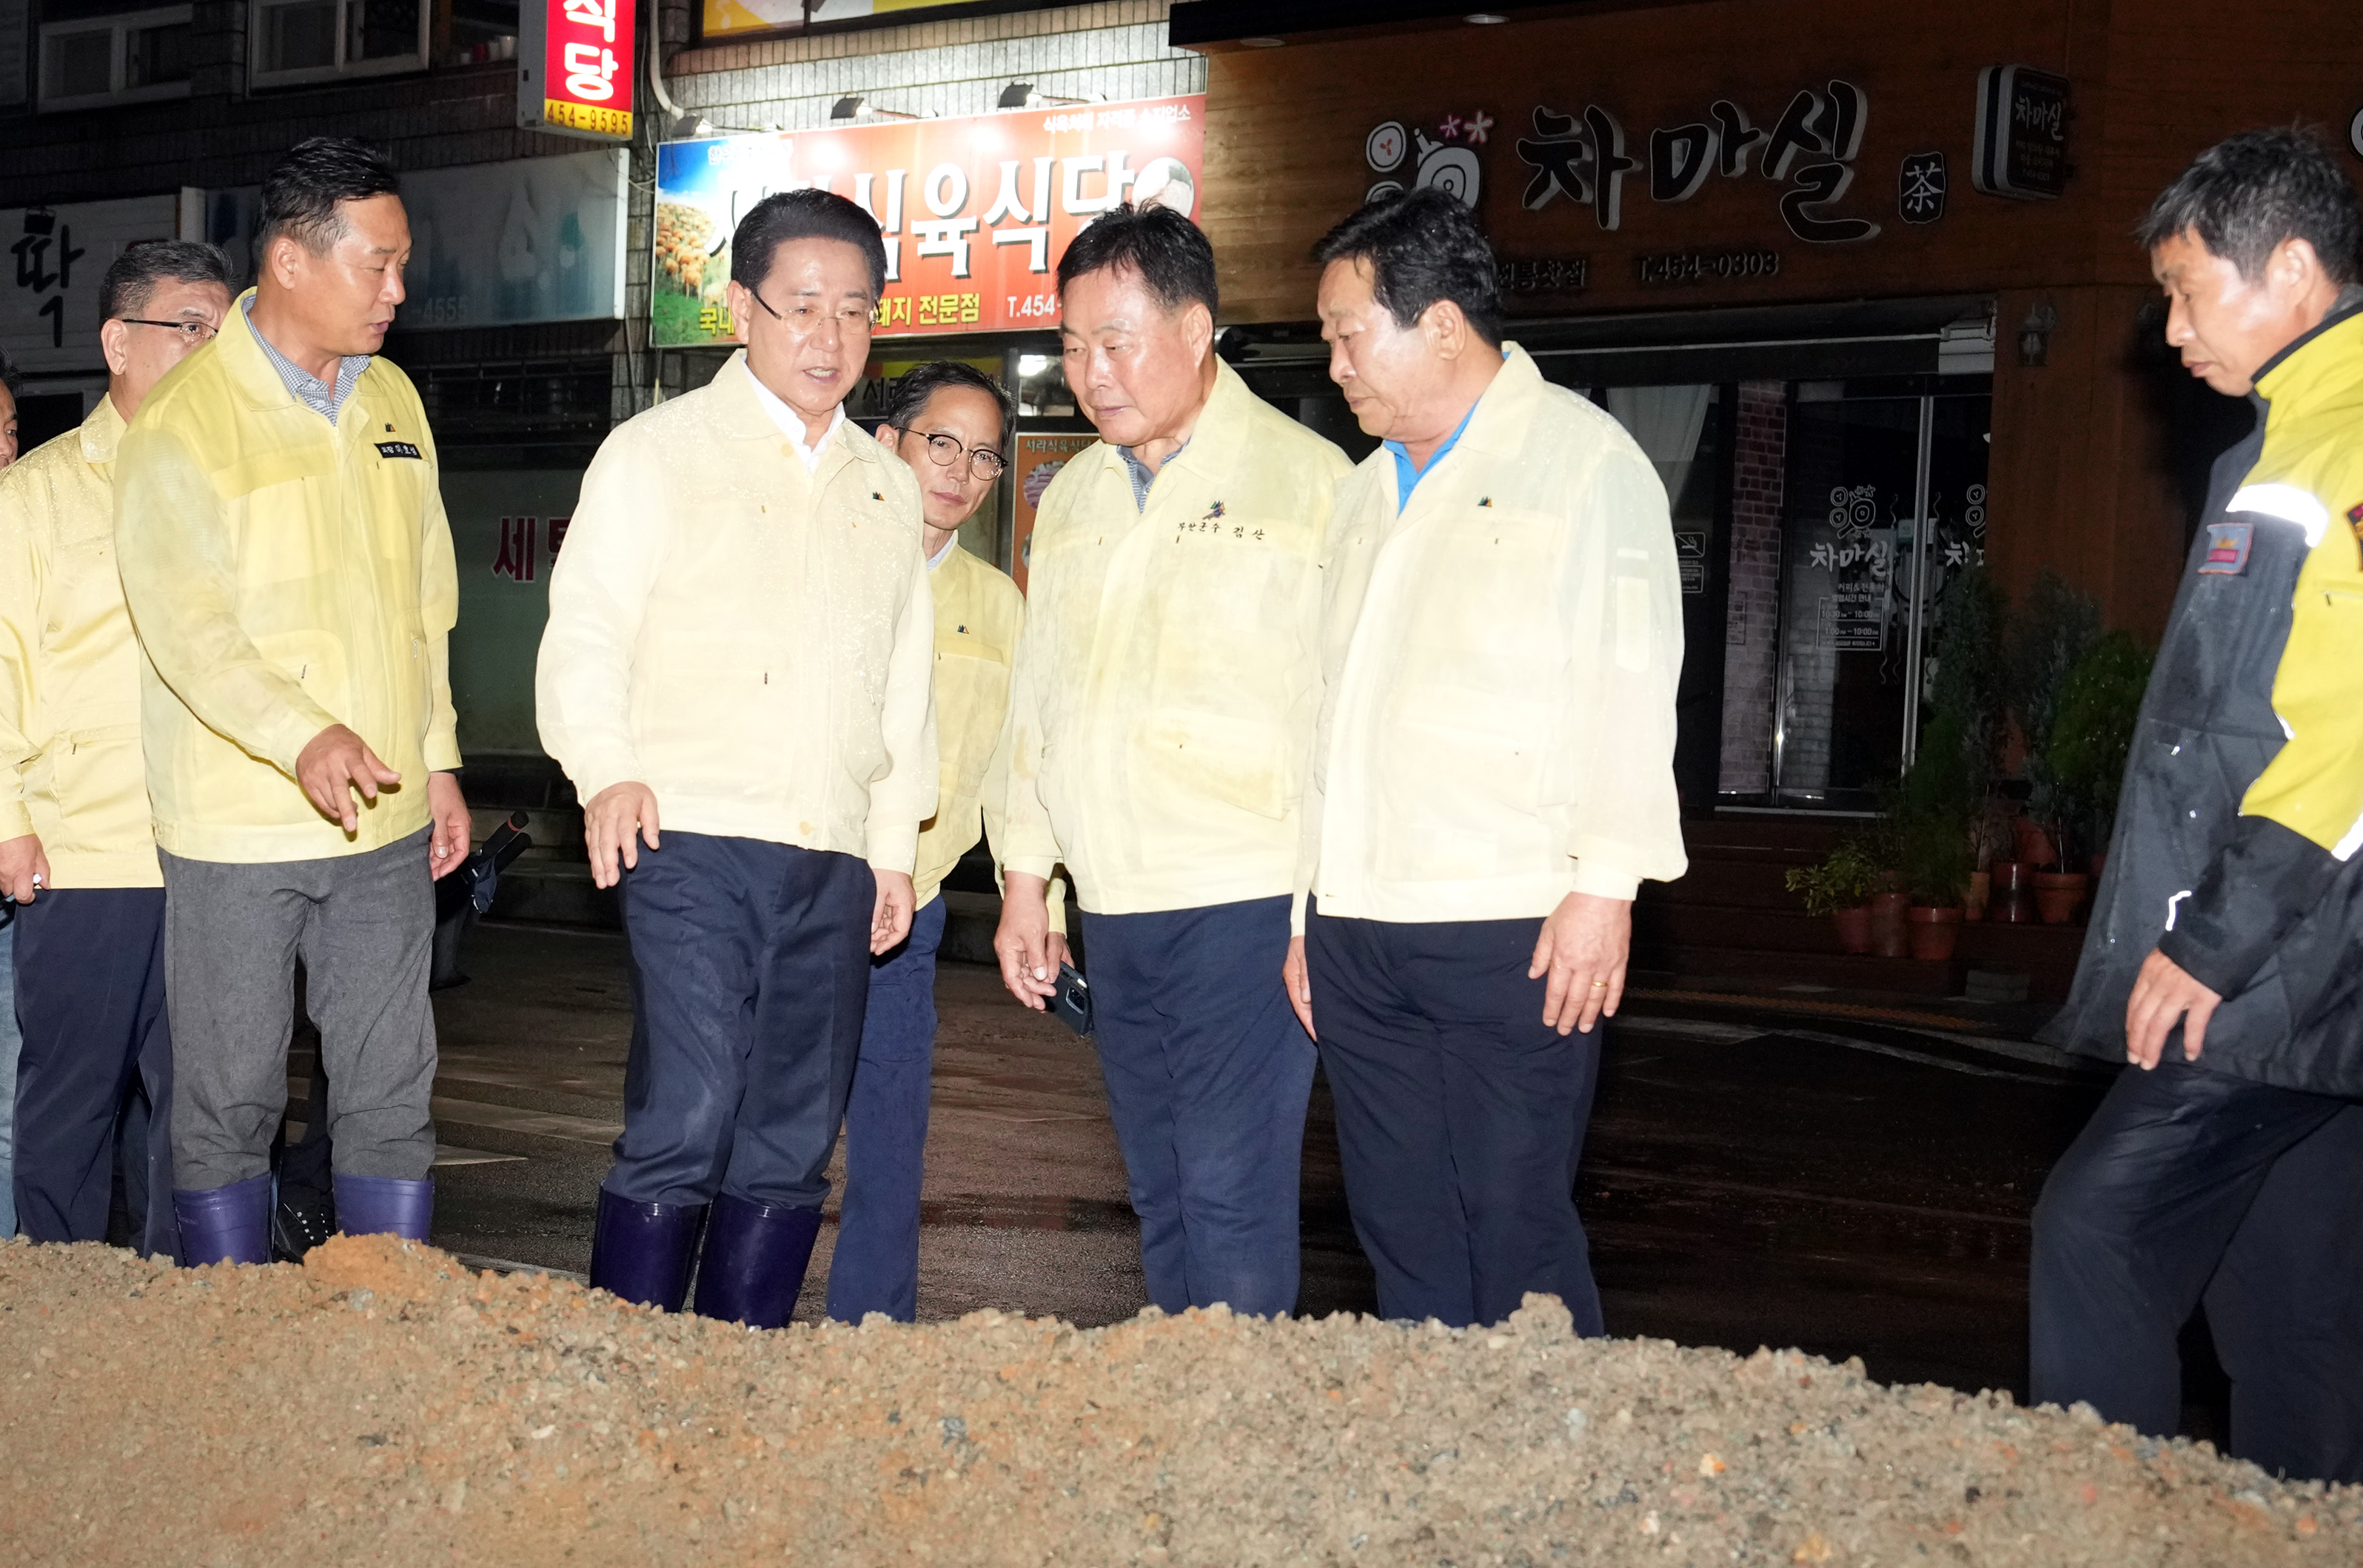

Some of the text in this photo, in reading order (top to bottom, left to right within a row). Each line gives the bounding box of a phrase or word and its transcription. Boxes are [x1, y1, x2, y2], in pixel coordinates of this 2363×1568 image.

[546, 102, 629, 135] 454-9595
[2015, 93, 2064, 141] 차마실
[1516, 78, 1881, 243] 차마실
[1906, 162, 1945, 213] 茶
[1635, 252, 1779, 283] T.454-0303
[919, 292, 981, 325] 전문점
[1809, 540, 1888, 577] 차마실
